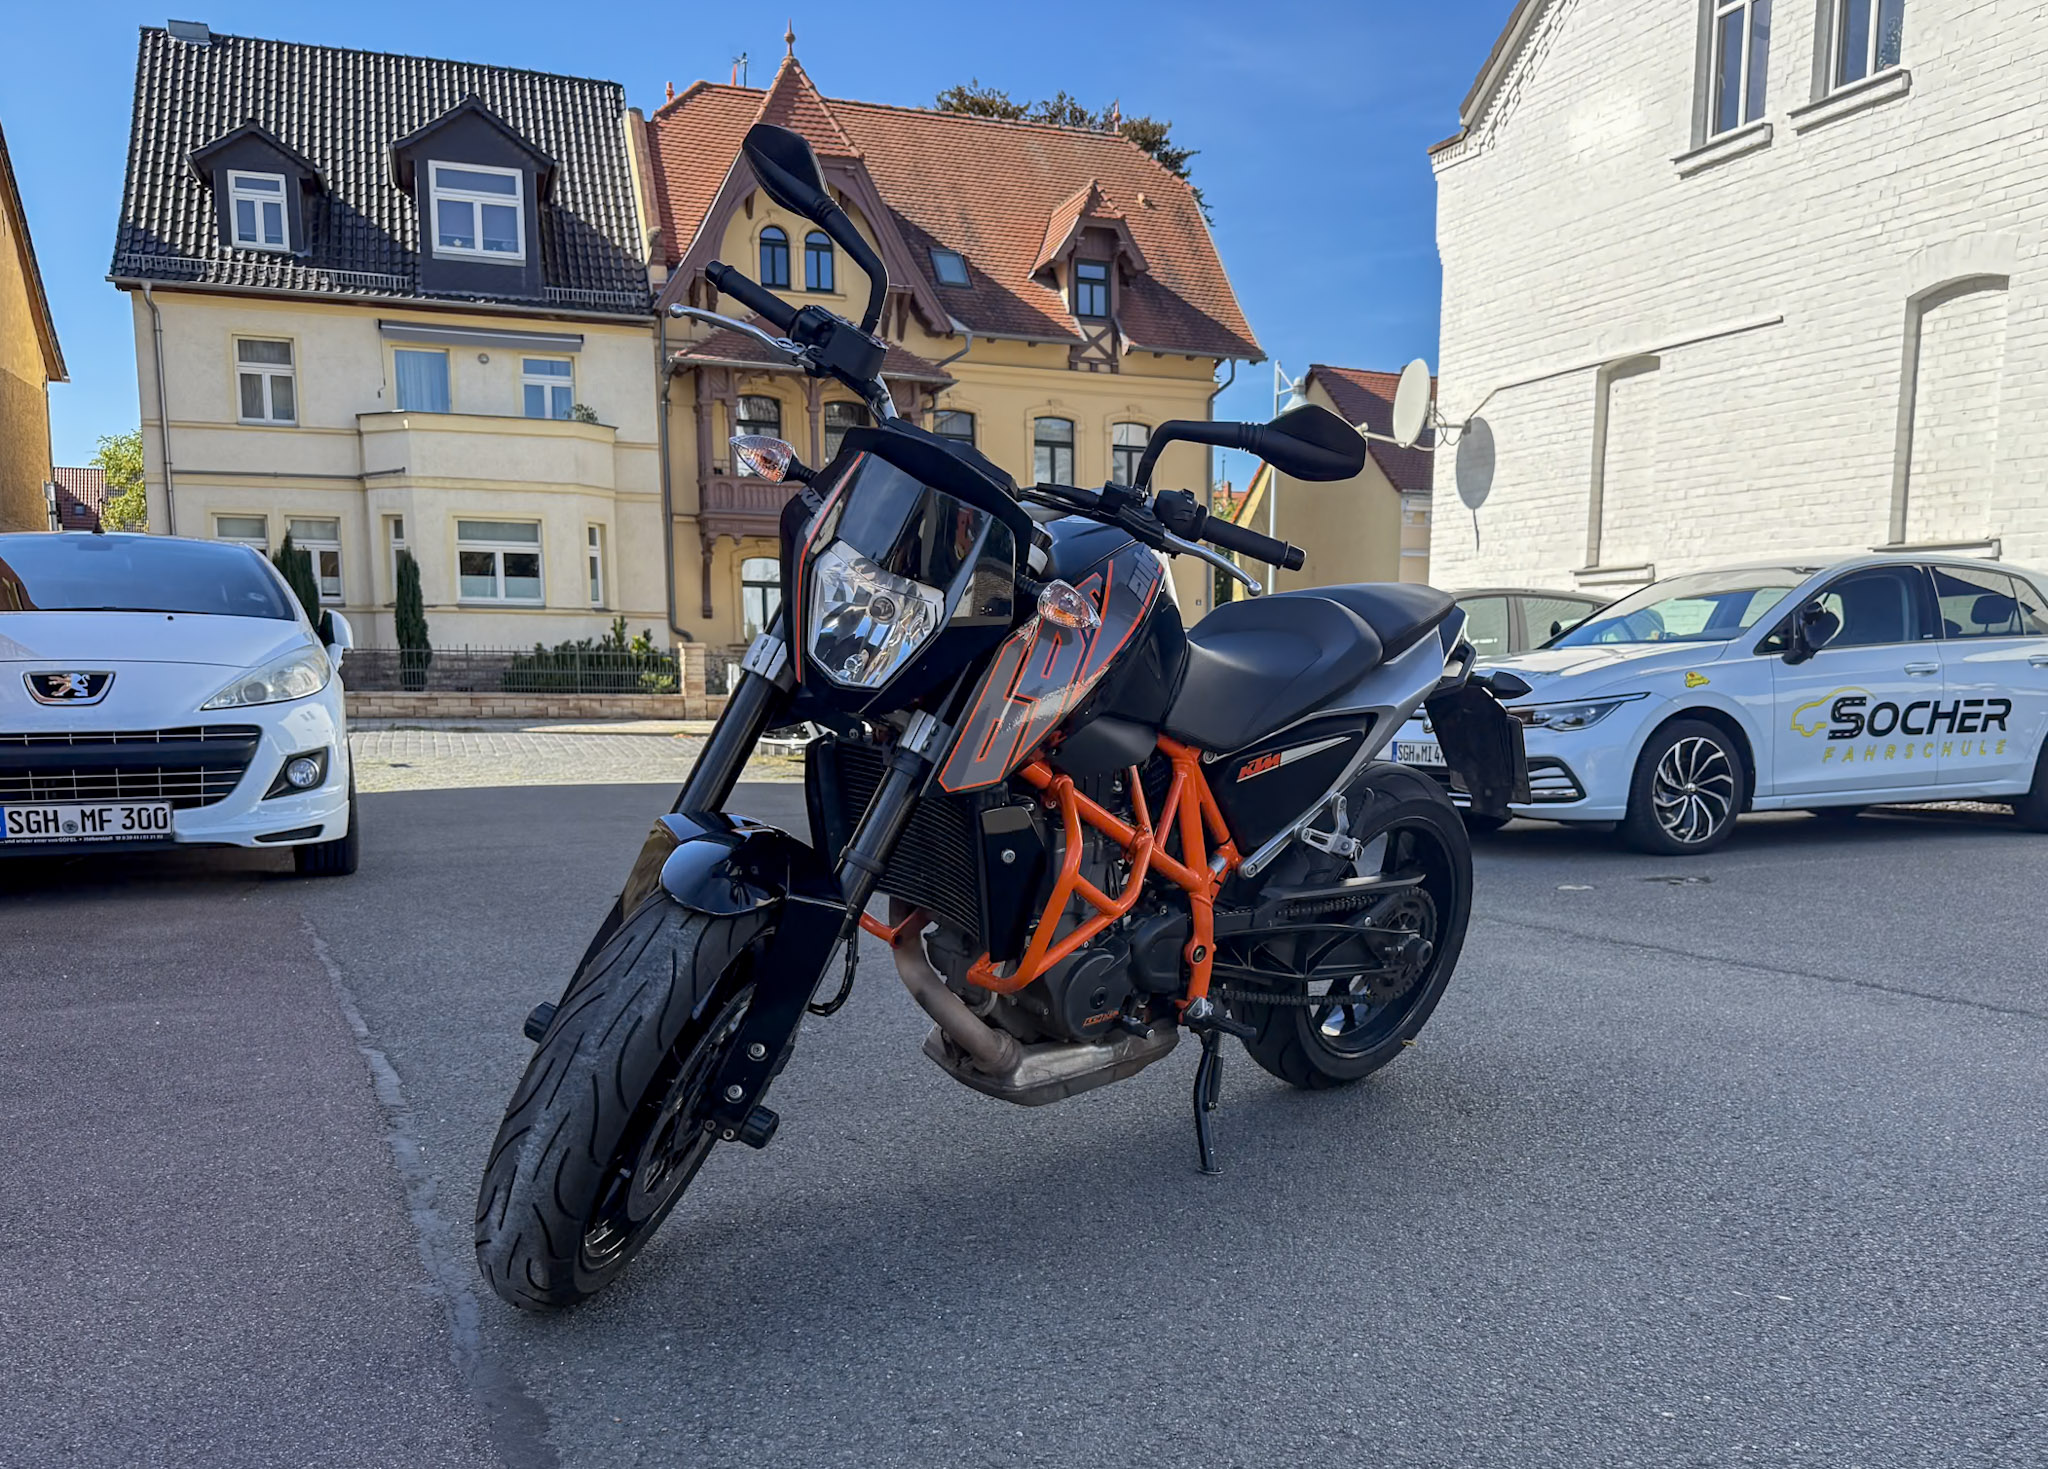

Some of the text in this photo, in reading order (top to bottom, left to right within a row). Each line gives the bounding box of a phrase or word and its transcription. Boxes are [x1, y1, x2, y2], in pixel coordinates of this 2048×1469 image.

[1827, 695, 2012, 741] SOCHER
[1397, 744, 1415, 762] SGH
[1421, 745, 1432, 763] MI
[1821, 739, 2008, 763] FAHRSCHULE
[1237, 752, 1281, 780] KTM
[8, 806, 169, 835] SGH MF 300
